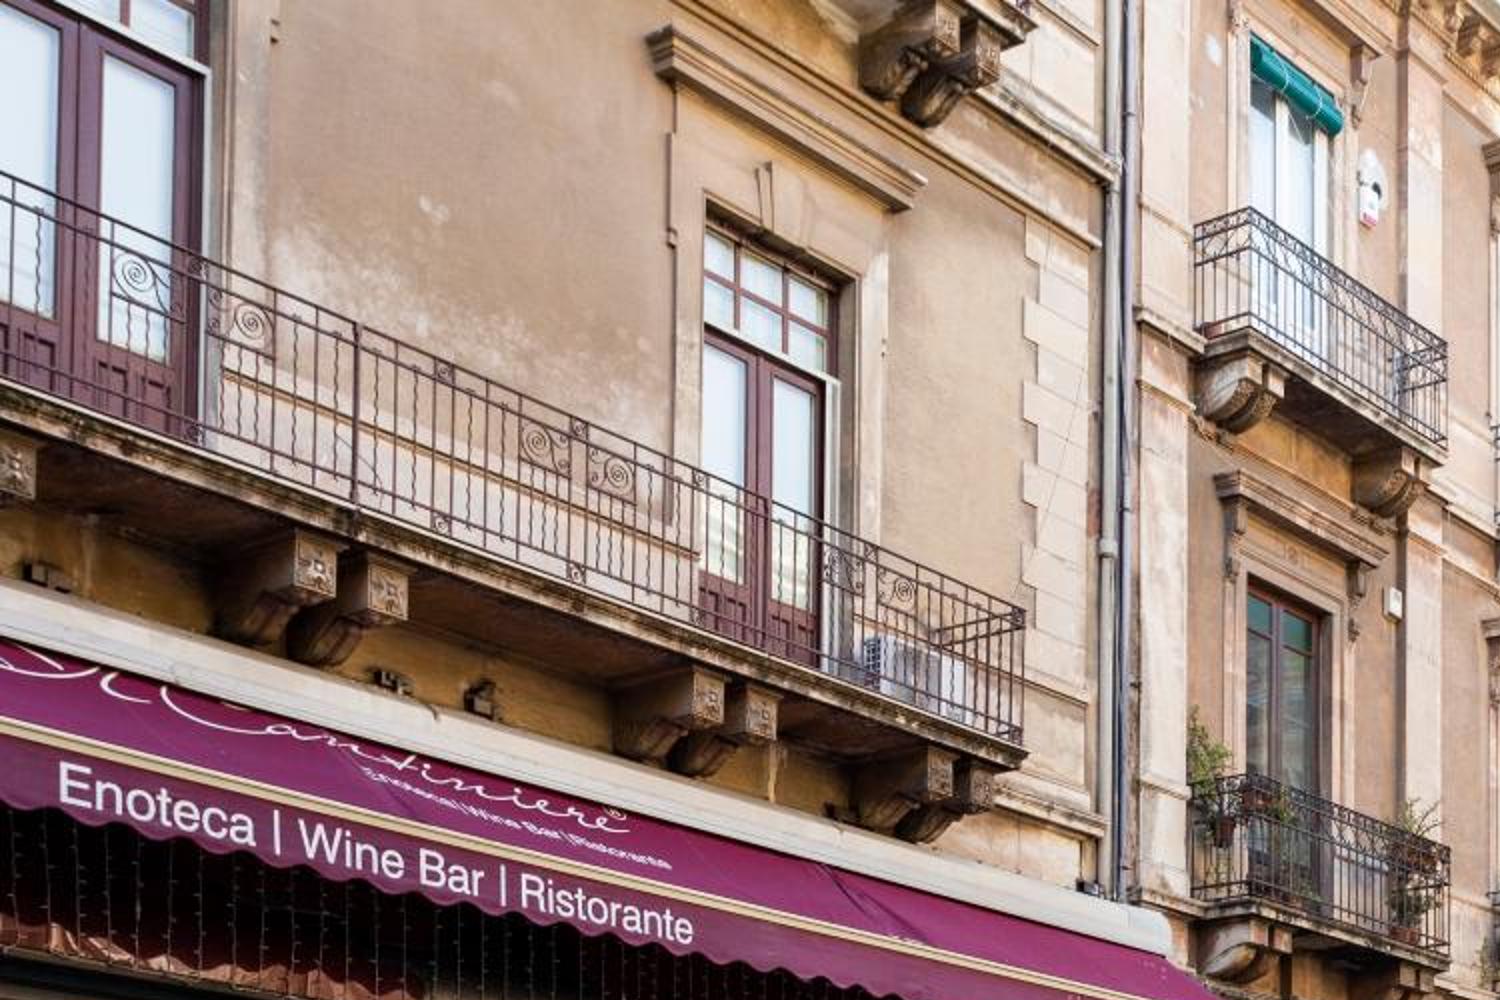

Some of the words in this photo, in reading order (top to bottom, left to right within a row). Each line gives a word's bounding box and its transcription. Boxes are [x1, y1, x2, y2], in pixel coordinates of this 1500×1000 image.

[59, 761, 256, 847] Enoteca
[298, 818, 405, 879] Wine
[419, 848, 485, 897] Bar
[521, 872, 694, 945] Ristorante
